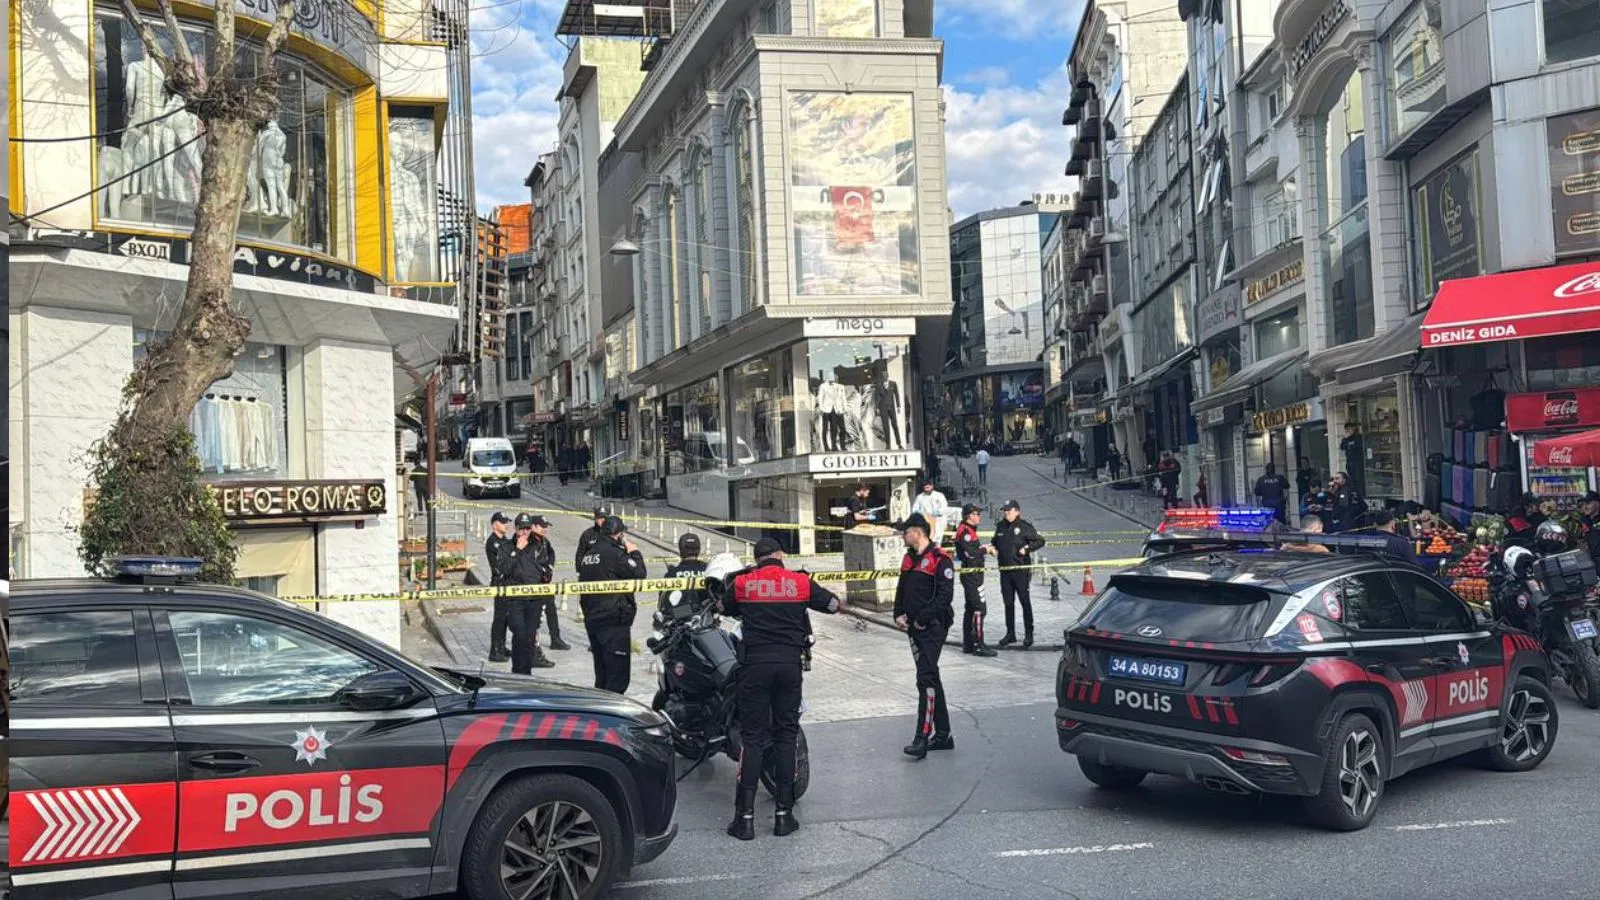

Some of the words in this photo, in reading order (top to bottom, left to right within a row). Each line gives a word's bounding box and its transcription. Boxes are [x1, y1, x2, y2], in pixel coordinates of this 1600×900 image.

[129, 242, 168, 260] ВХОД
[836, 318, 884, 333] mega
[1430, 327, 1476, 344] DENİZ
[1479, 324, 1517, 339] GIDA
[822, 454, 908, 468] GIOBERTI
[287, 486, 358, 512] ROMA
[1112, 658, 1126, 672] 34
[1129, 661, 1139, 674] A
[1142, 662, 1179, 680] 80153
